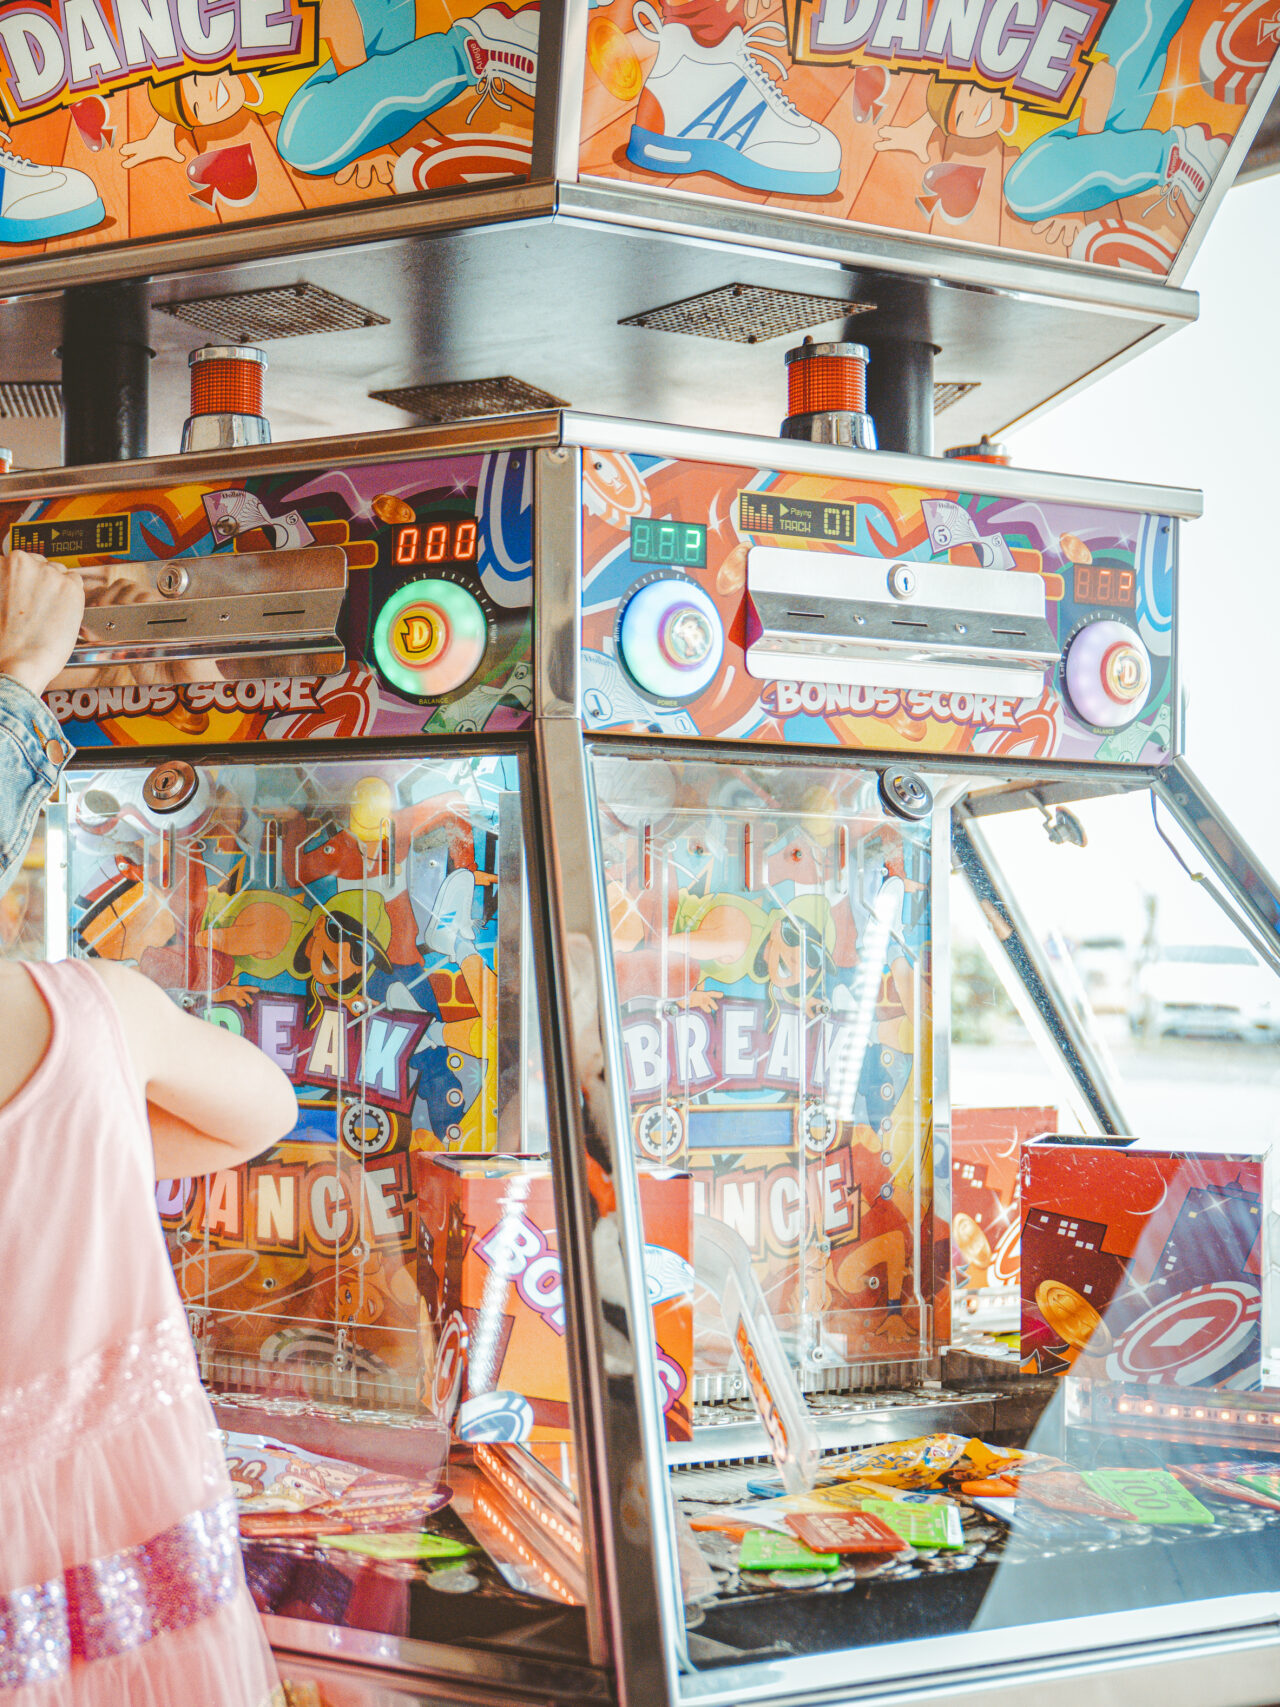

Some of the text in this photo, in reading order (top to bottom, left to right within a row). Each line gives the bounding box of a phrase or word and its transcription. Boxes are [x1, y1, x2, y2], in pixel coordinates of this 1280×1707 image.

[815, 0, 1092, 92] DANCE
[677, 75, 768, 152] AA
[96, 521, 124, 548] 01
[824, 507, 850, 536] 01
[938, 528, 948, 543] 5
[397, 523, 476, 562] 000
[48, 676, 320, 720] BONUS SCORE
[419, 696, 449, 705] BALANCE
[777, 681, 1019, 727] BONUS SCORE
